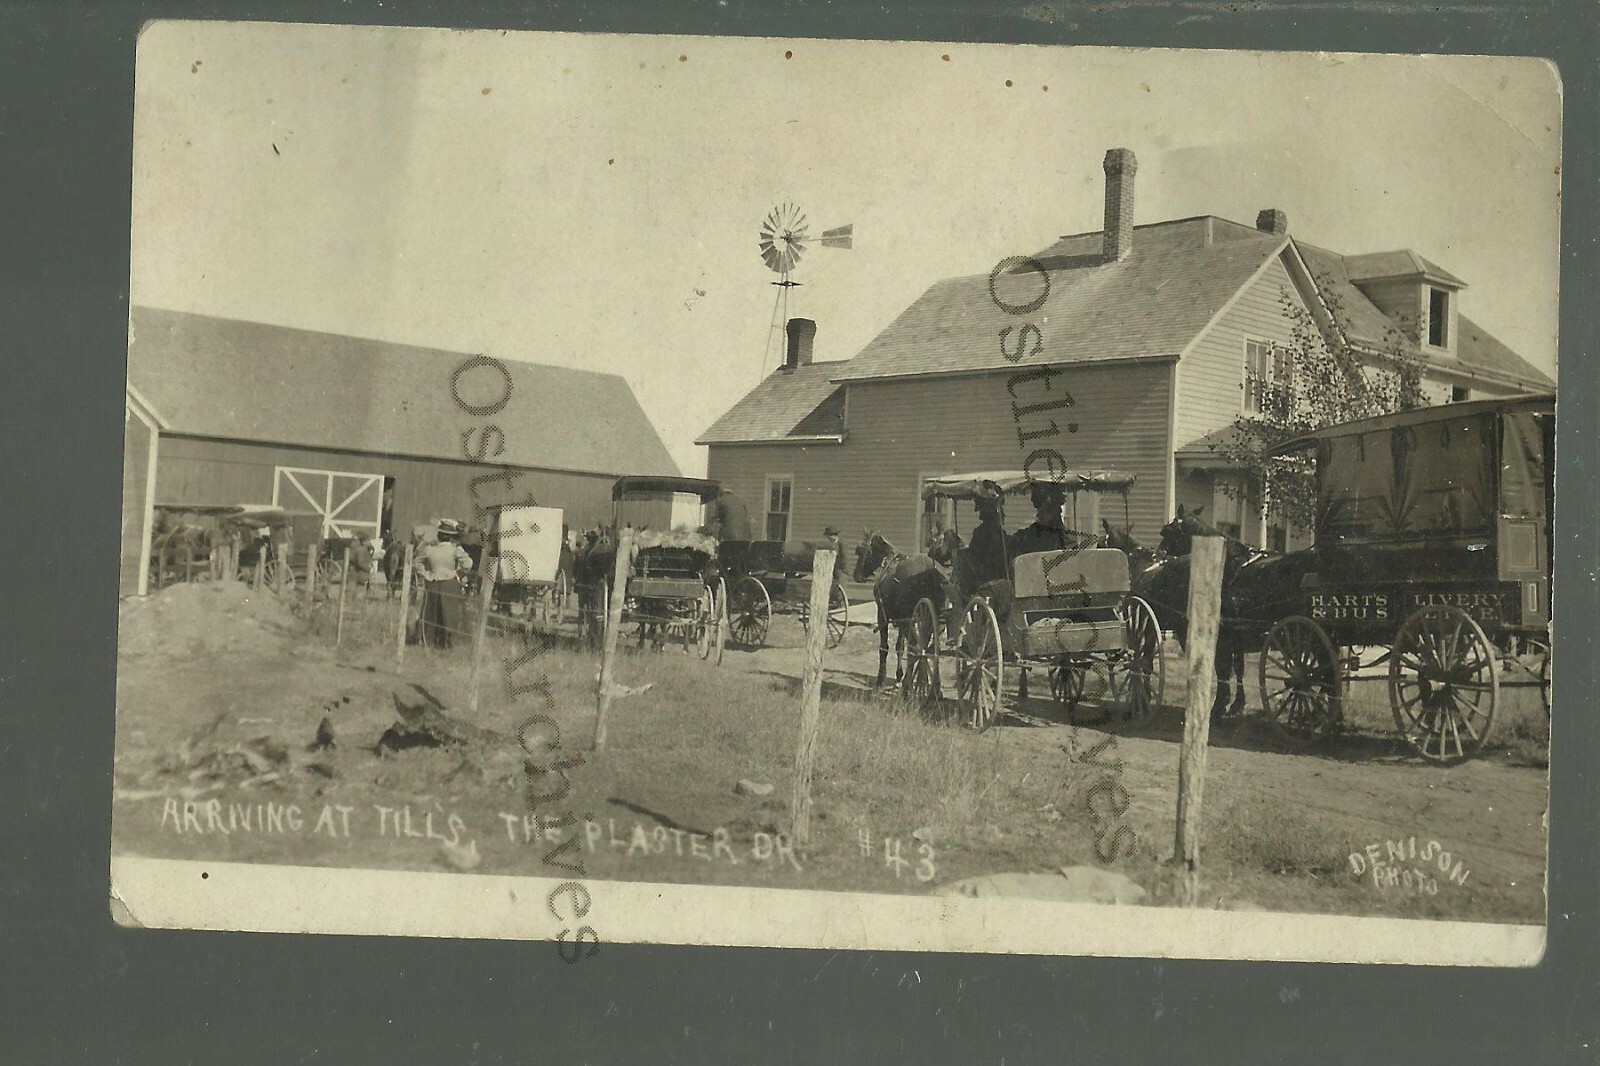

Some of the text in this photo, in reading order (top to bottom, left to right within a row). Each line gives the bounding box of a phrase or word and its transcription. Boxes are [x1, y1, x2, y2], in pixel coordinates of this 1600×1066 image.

[1311, 593, 1506, 608] HART'S LIVERY
[1312, 607, 1327, 619] &
[1333, 607, 1389, 620] BUS
